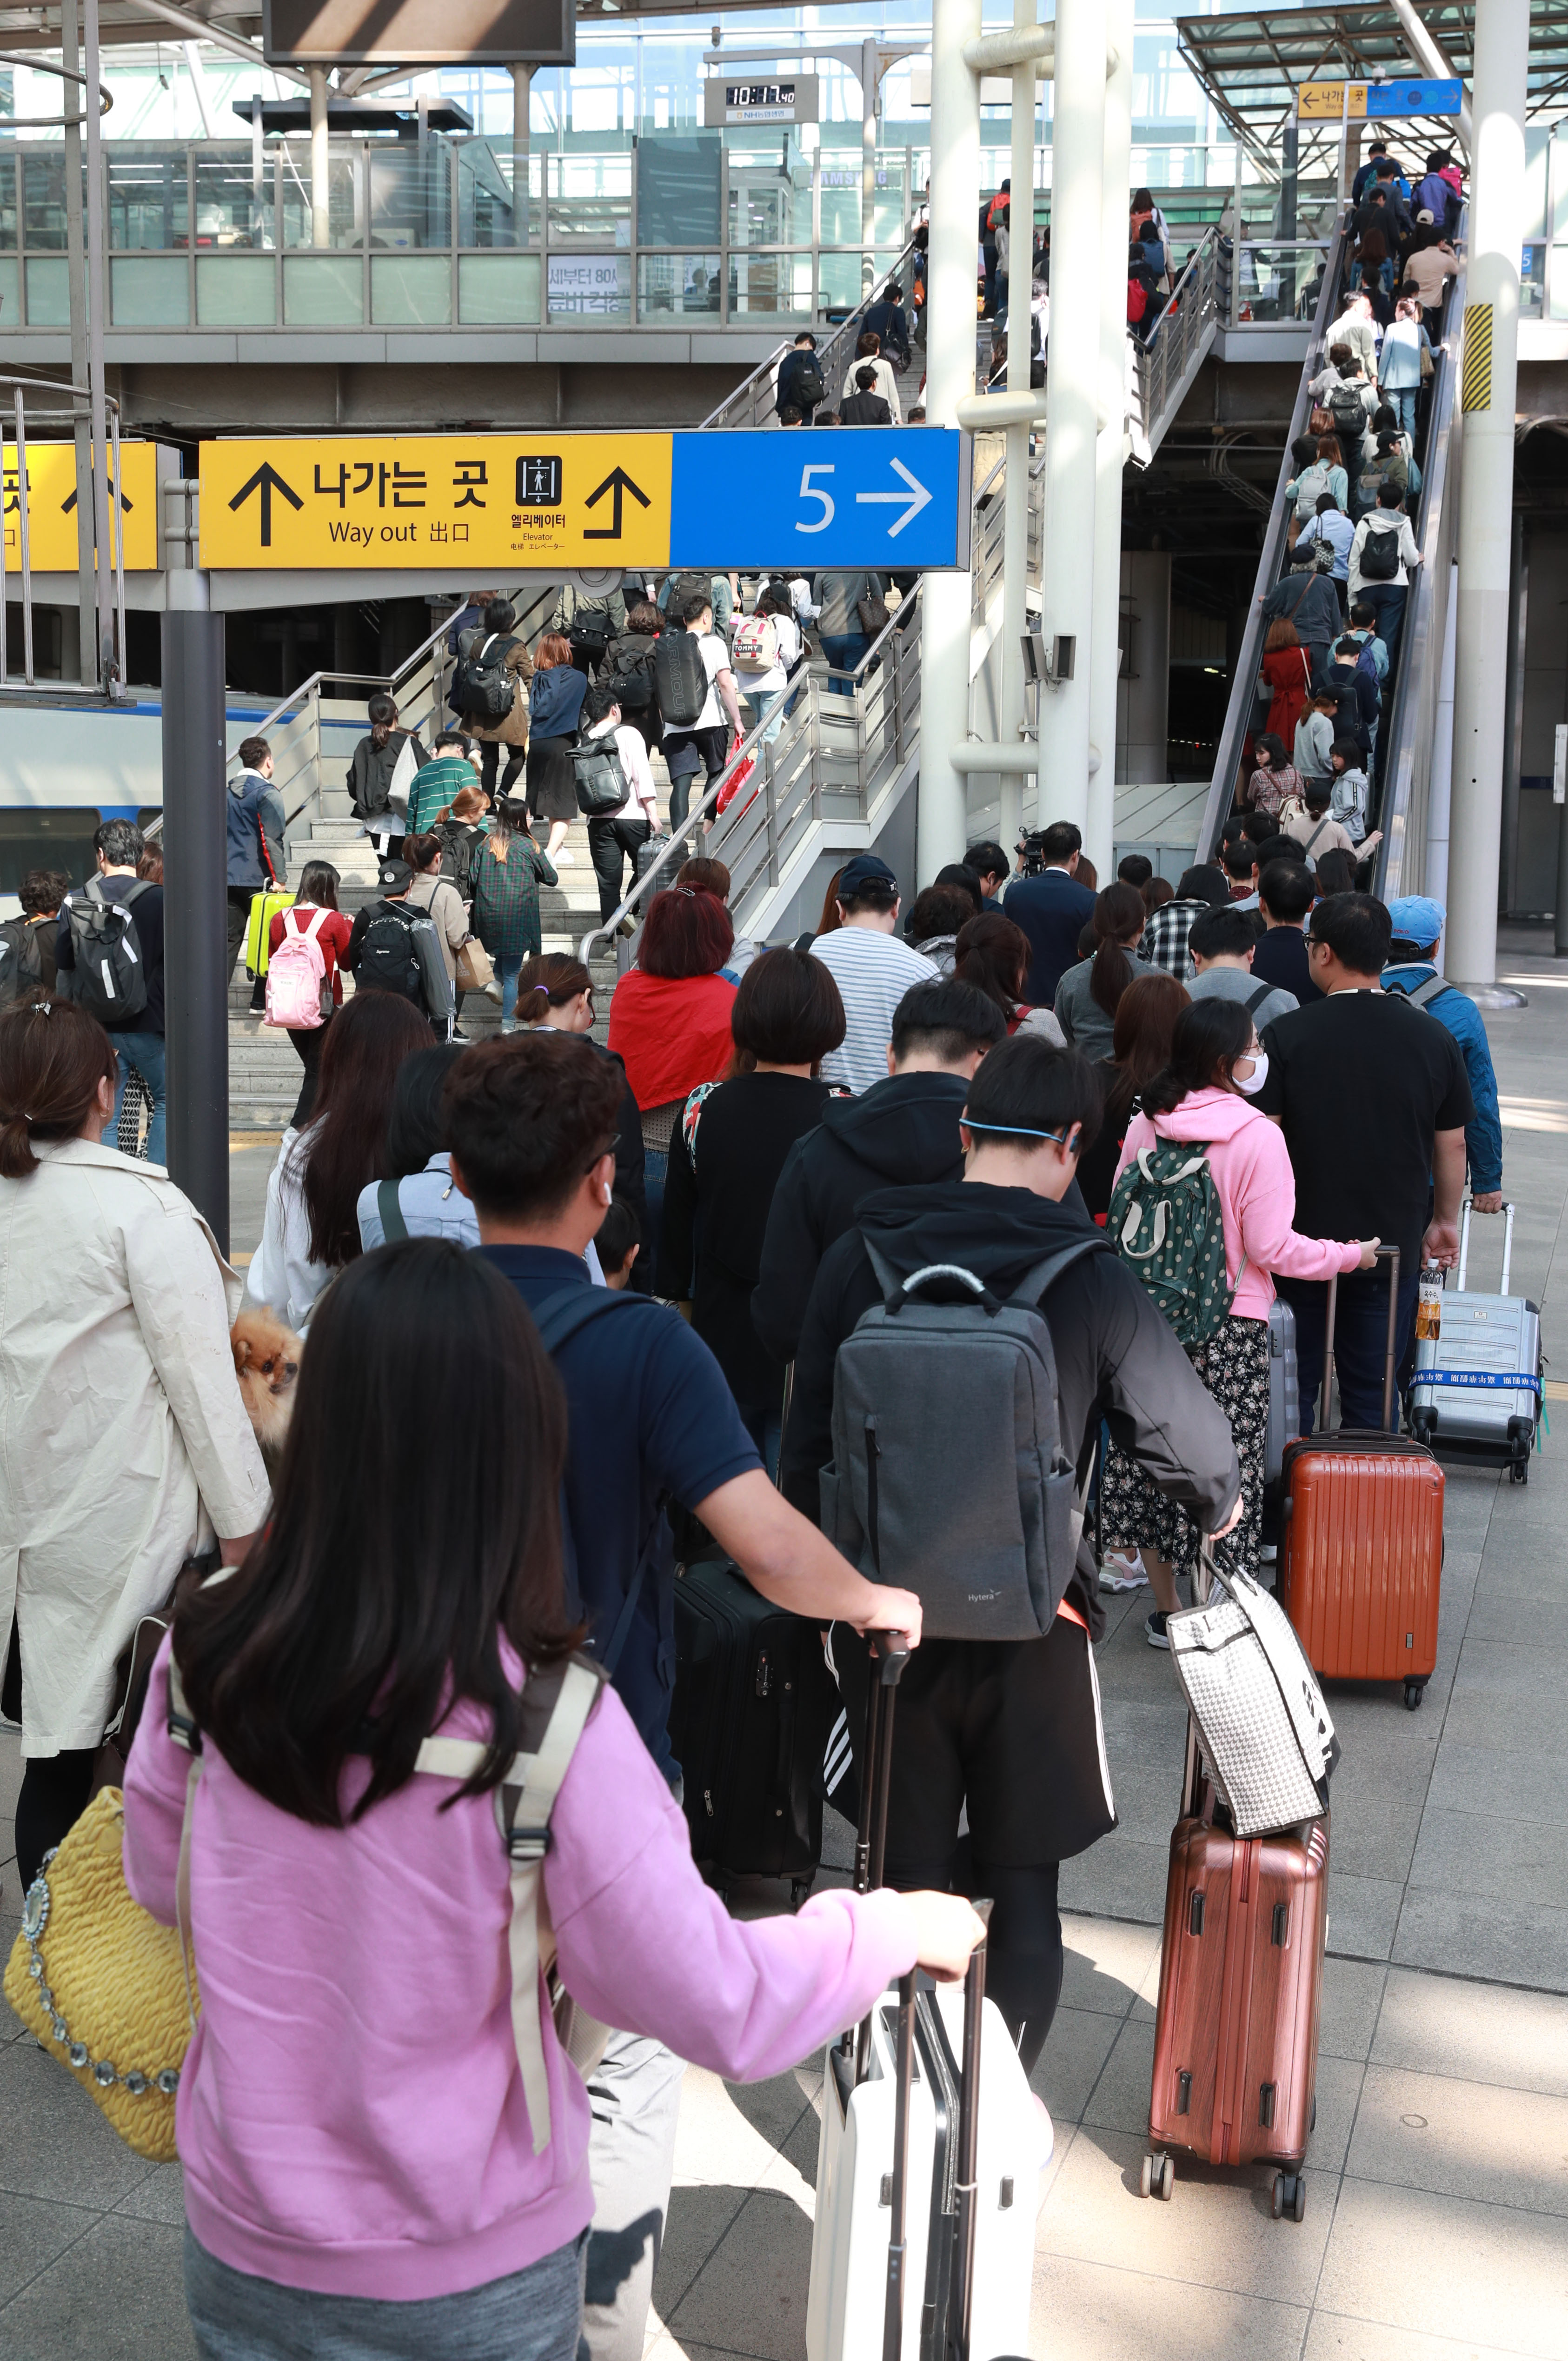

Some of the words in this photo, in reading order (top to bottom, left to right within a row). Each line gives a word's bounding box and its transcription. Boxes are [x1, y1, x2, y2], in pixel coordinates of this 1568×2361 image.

[1355, 90, 1363, 102] 곳
[810, 171, 887, 185] AMSG
[1522, 253, 1531, 267] 5
[314, 461, 427, 508] 나가는
[452, 461, 488, 508] 곳
[795, 464, 835, 533] 5
[511, 514, 565, 528] 엘리베이터
[328, 522, 374, 548] Way
[380, 522, 417, 542] out
[430, 521, 469, 543] 出口
[1450, 1374, 1496, 1385] 嘉年華假期
[968, 1594, 994, 1603] Hytera
